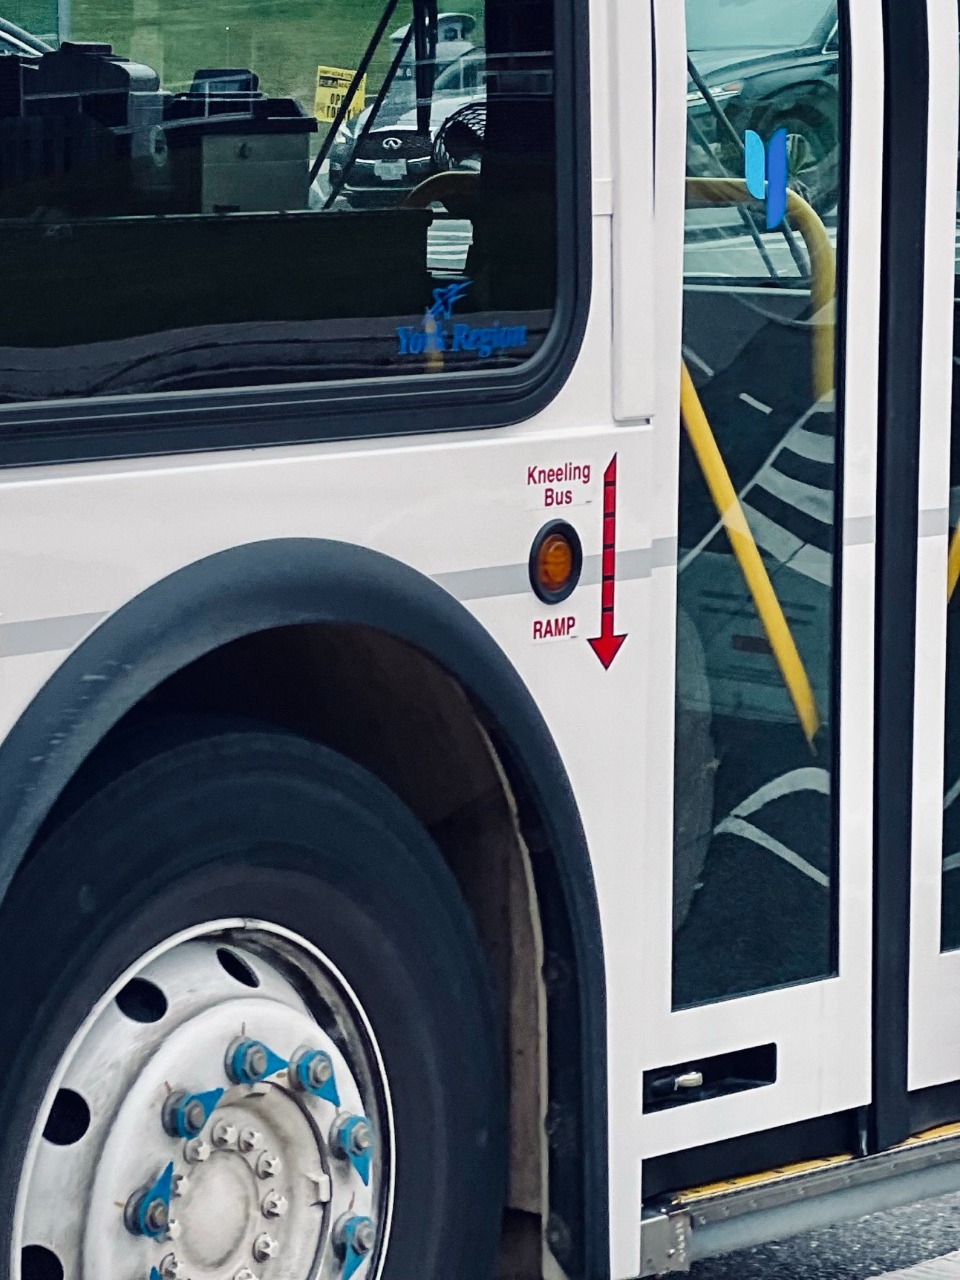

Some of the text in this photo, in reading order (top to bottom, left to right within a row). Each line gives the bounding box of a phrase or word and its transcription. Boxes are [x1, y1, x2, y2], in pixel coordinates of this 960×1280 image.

[451, 323, 528, 358] Region
[527, 462, 591, 485] Kneeling
[544, 488, 573, 507] Bus
[532, 616, 576, 639] RAMP
